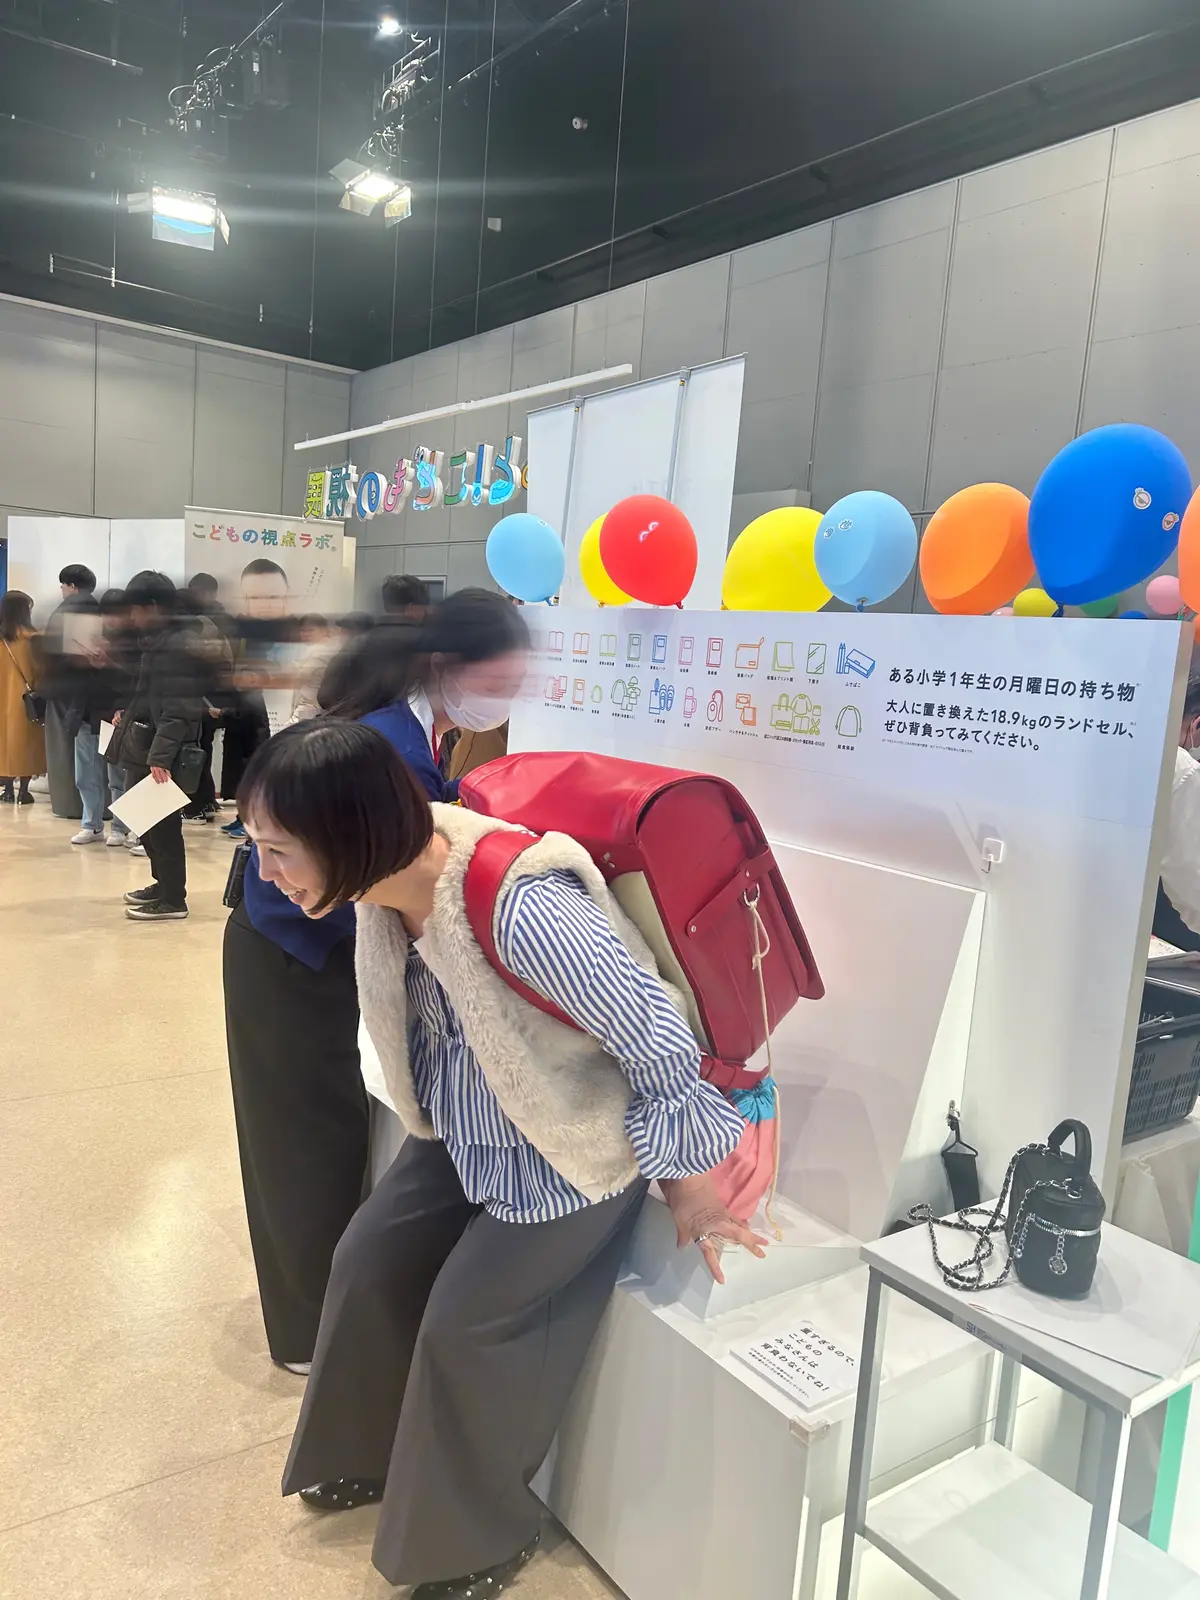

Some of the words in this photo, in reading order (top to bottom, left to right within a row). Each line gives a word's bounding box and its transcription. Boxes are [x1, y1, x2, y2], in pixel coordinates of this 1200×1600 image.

[889, 667, 1136, 702] ある小学1年生の月曜日の持ち物
[884, 719, 1040, 751] ぜひ背負ってみてください。
[774, 1338, 819, 1368] みなさんは
[788, 1333, 823, 1356] こどもの
